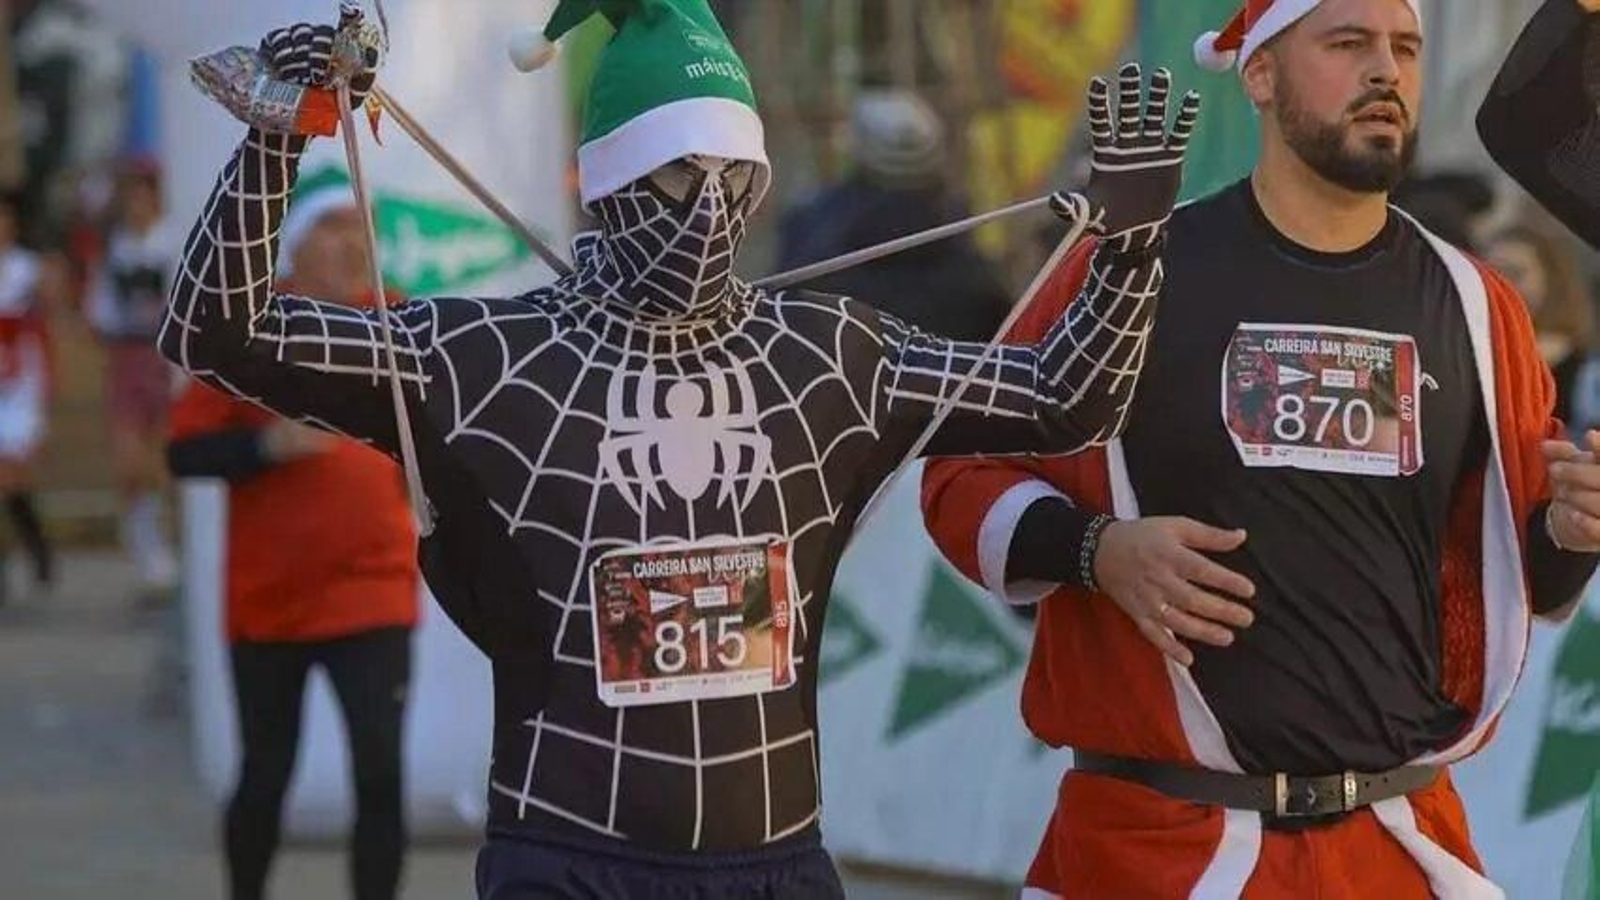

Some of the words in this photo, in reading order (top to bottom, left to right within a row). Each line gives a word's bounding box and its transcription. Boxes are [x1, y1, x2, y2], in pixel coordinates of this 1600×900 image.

[1264, 338, 1318, 355] CARREIRA
[1320, 340, 1341, 356] SAN
[1343, 343, 1393, 363] SILVESTRE
[1273, 393, 1375, 447] 870
[1400, 394, 1413, 422] 870
[633, 557, 688, 578] CARREIRA
[689, 556, 711, 575] SAN
[713, 551, 765, 572] SILVESTRE
[775, 601, 788, 628] 815
[654, 615, 747, 674] 815
